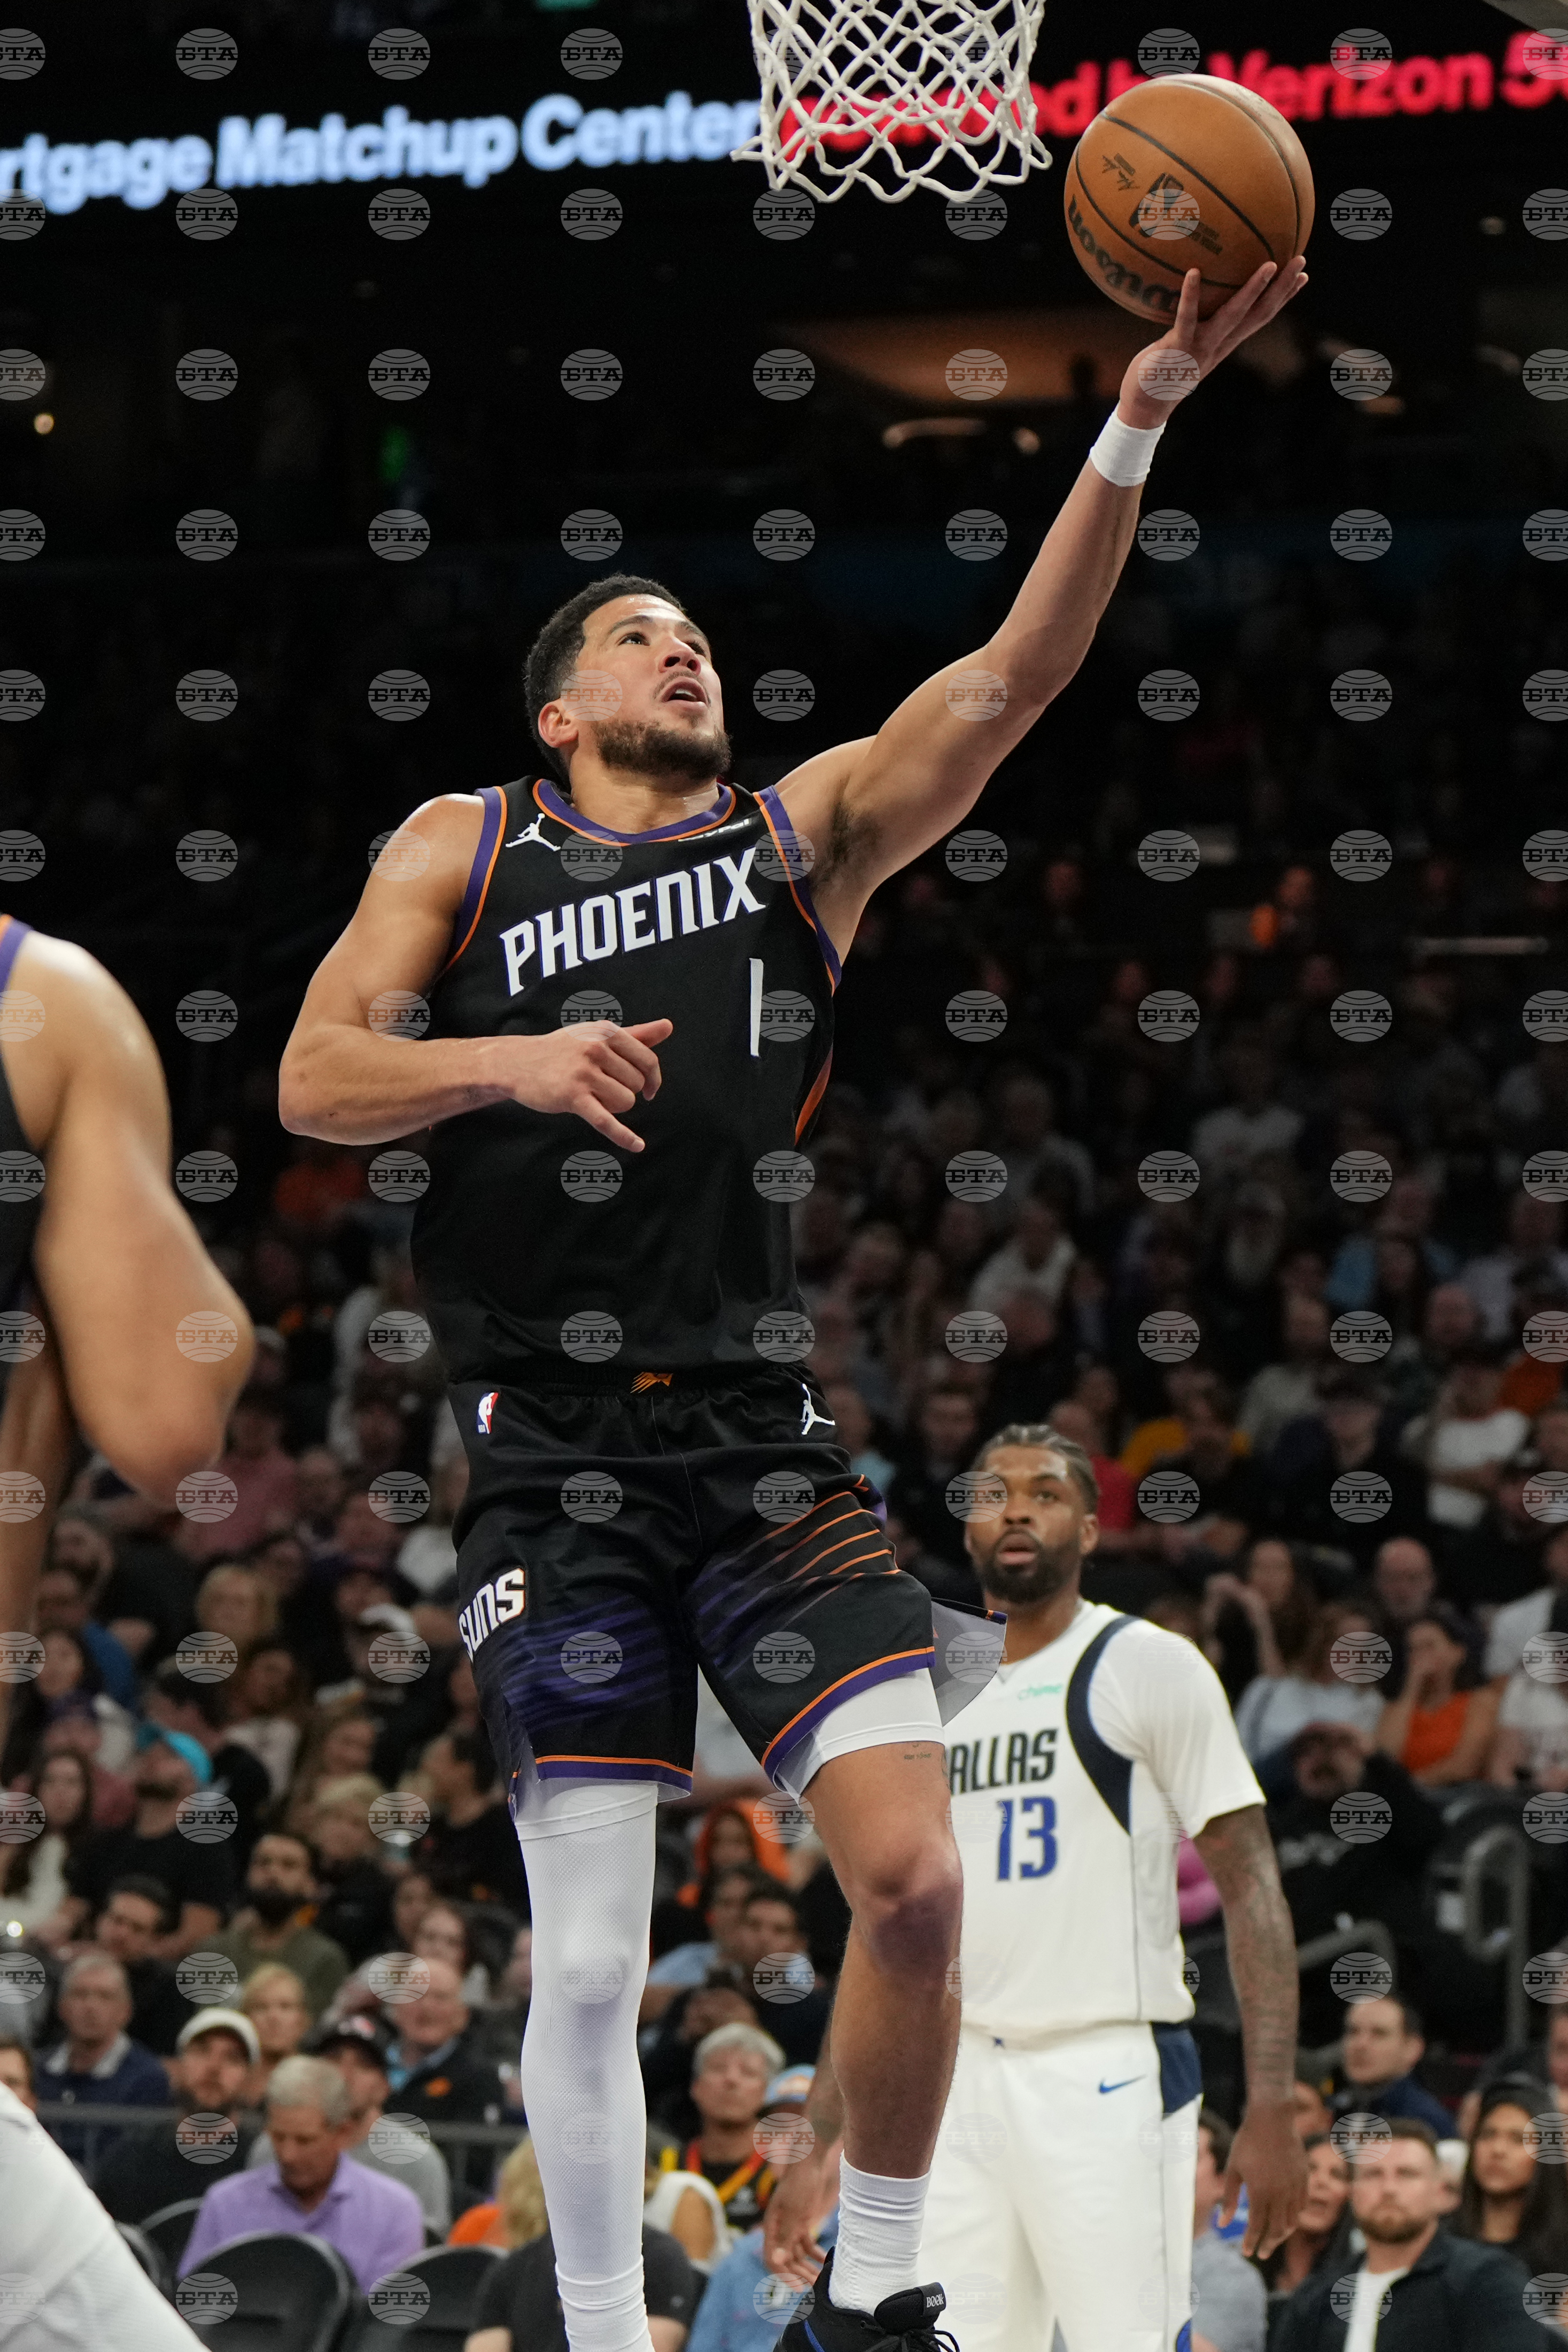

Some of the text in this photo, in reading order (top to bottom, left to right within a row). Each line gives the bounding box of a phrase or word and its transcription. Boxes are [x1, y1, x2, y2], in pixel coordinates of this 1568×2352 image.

[1205, 43, 1494, 122] Verizon
[1501, 30, 1568, 110] 5
[215, 103, 518, 189] Matchup
[522, 89, 762, 172] Center
[500, 847, 766, 996] PHOENIX
[749, 958, 764, 1057] 1
[458, 1567, 525, 1663] SUNS
[944, 1728, 1059, 1796] ALLAS
[997, 1796, 1057, 1881] 13
